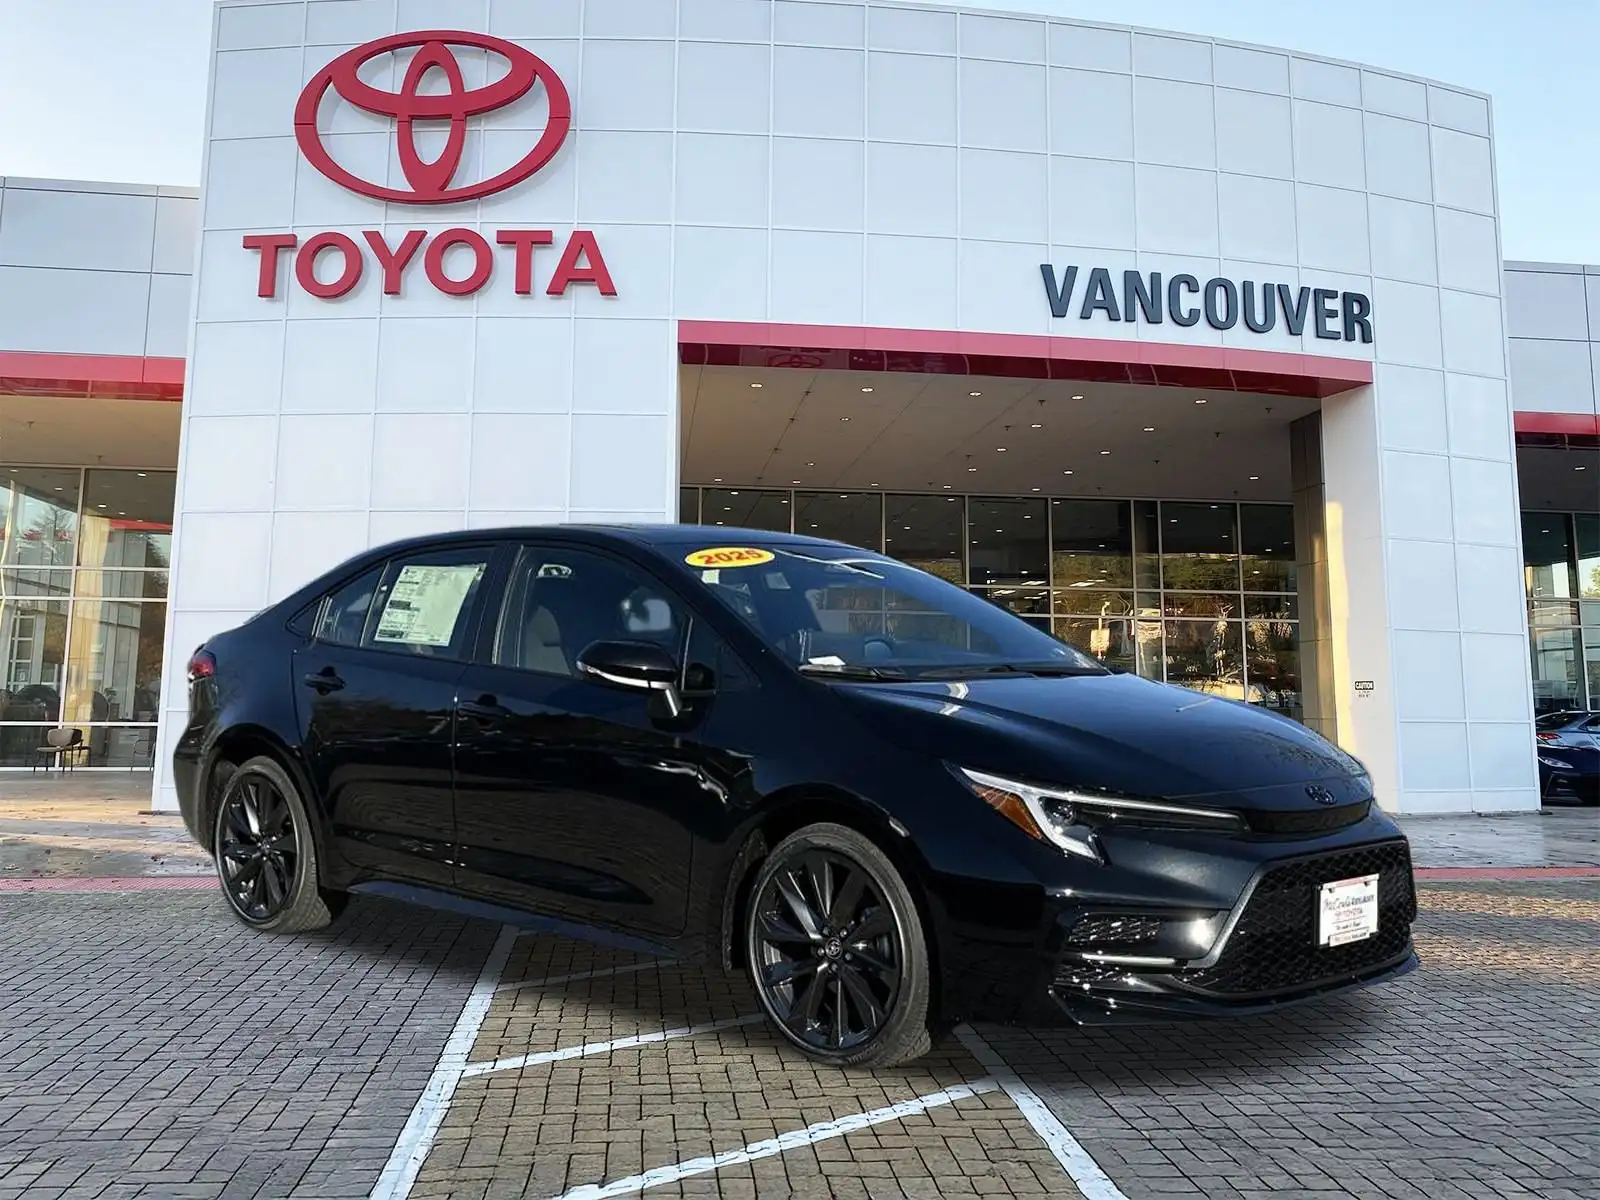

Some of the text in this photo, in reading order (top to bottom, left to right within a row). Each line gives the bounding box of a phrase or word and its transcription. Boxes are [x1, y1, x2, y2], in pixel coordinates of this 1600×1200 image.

[243, 228, 618, 298] TOYOTA
[1040, 264, 1373, 343] VANCOUVER
[698, 549, 763, 565] 2025
